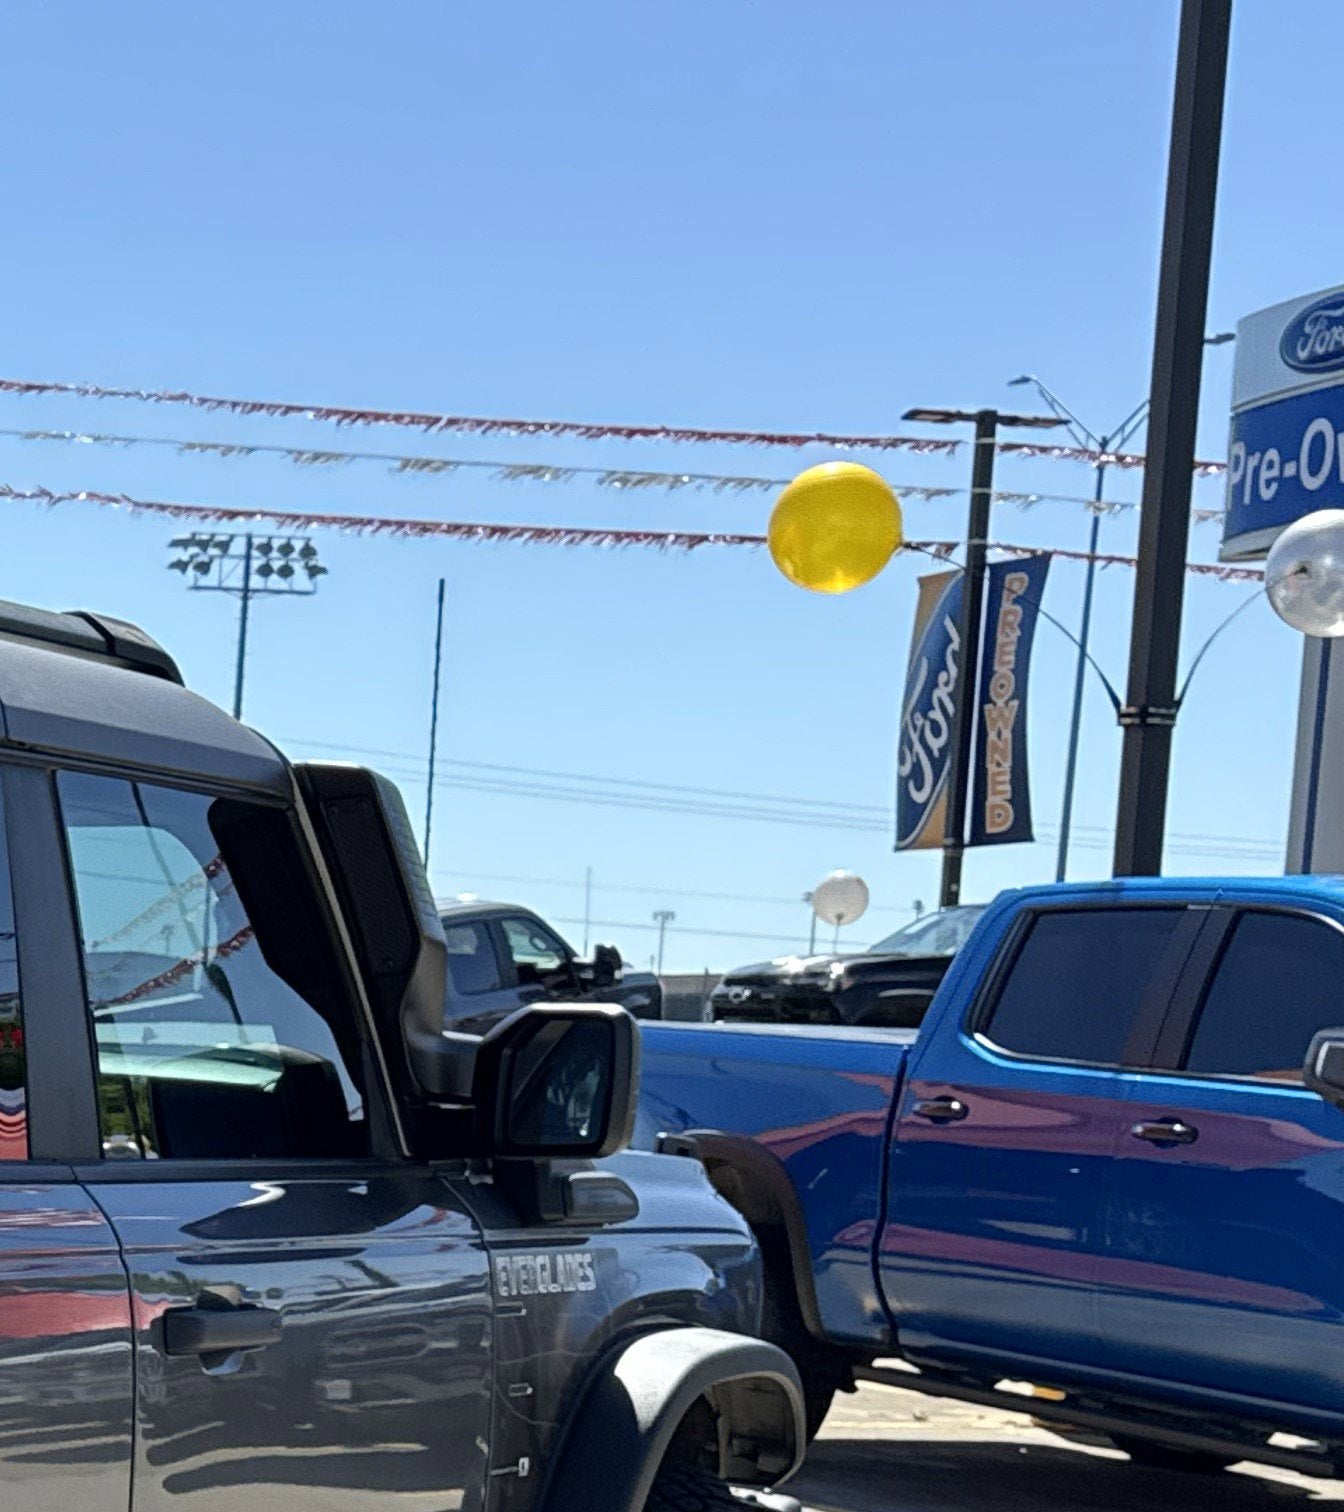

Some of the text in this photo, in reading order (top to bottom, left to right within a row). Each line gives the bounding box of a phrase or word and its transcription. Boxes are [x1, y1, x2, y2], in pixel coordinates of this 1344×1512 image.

[1297, 306, 1344, 360] For
[1227, 417, 1344, 508] Pre-O
[899, 614, 961, 803] Ford
[496, 1253, 597, 1296] EVERGLADES
